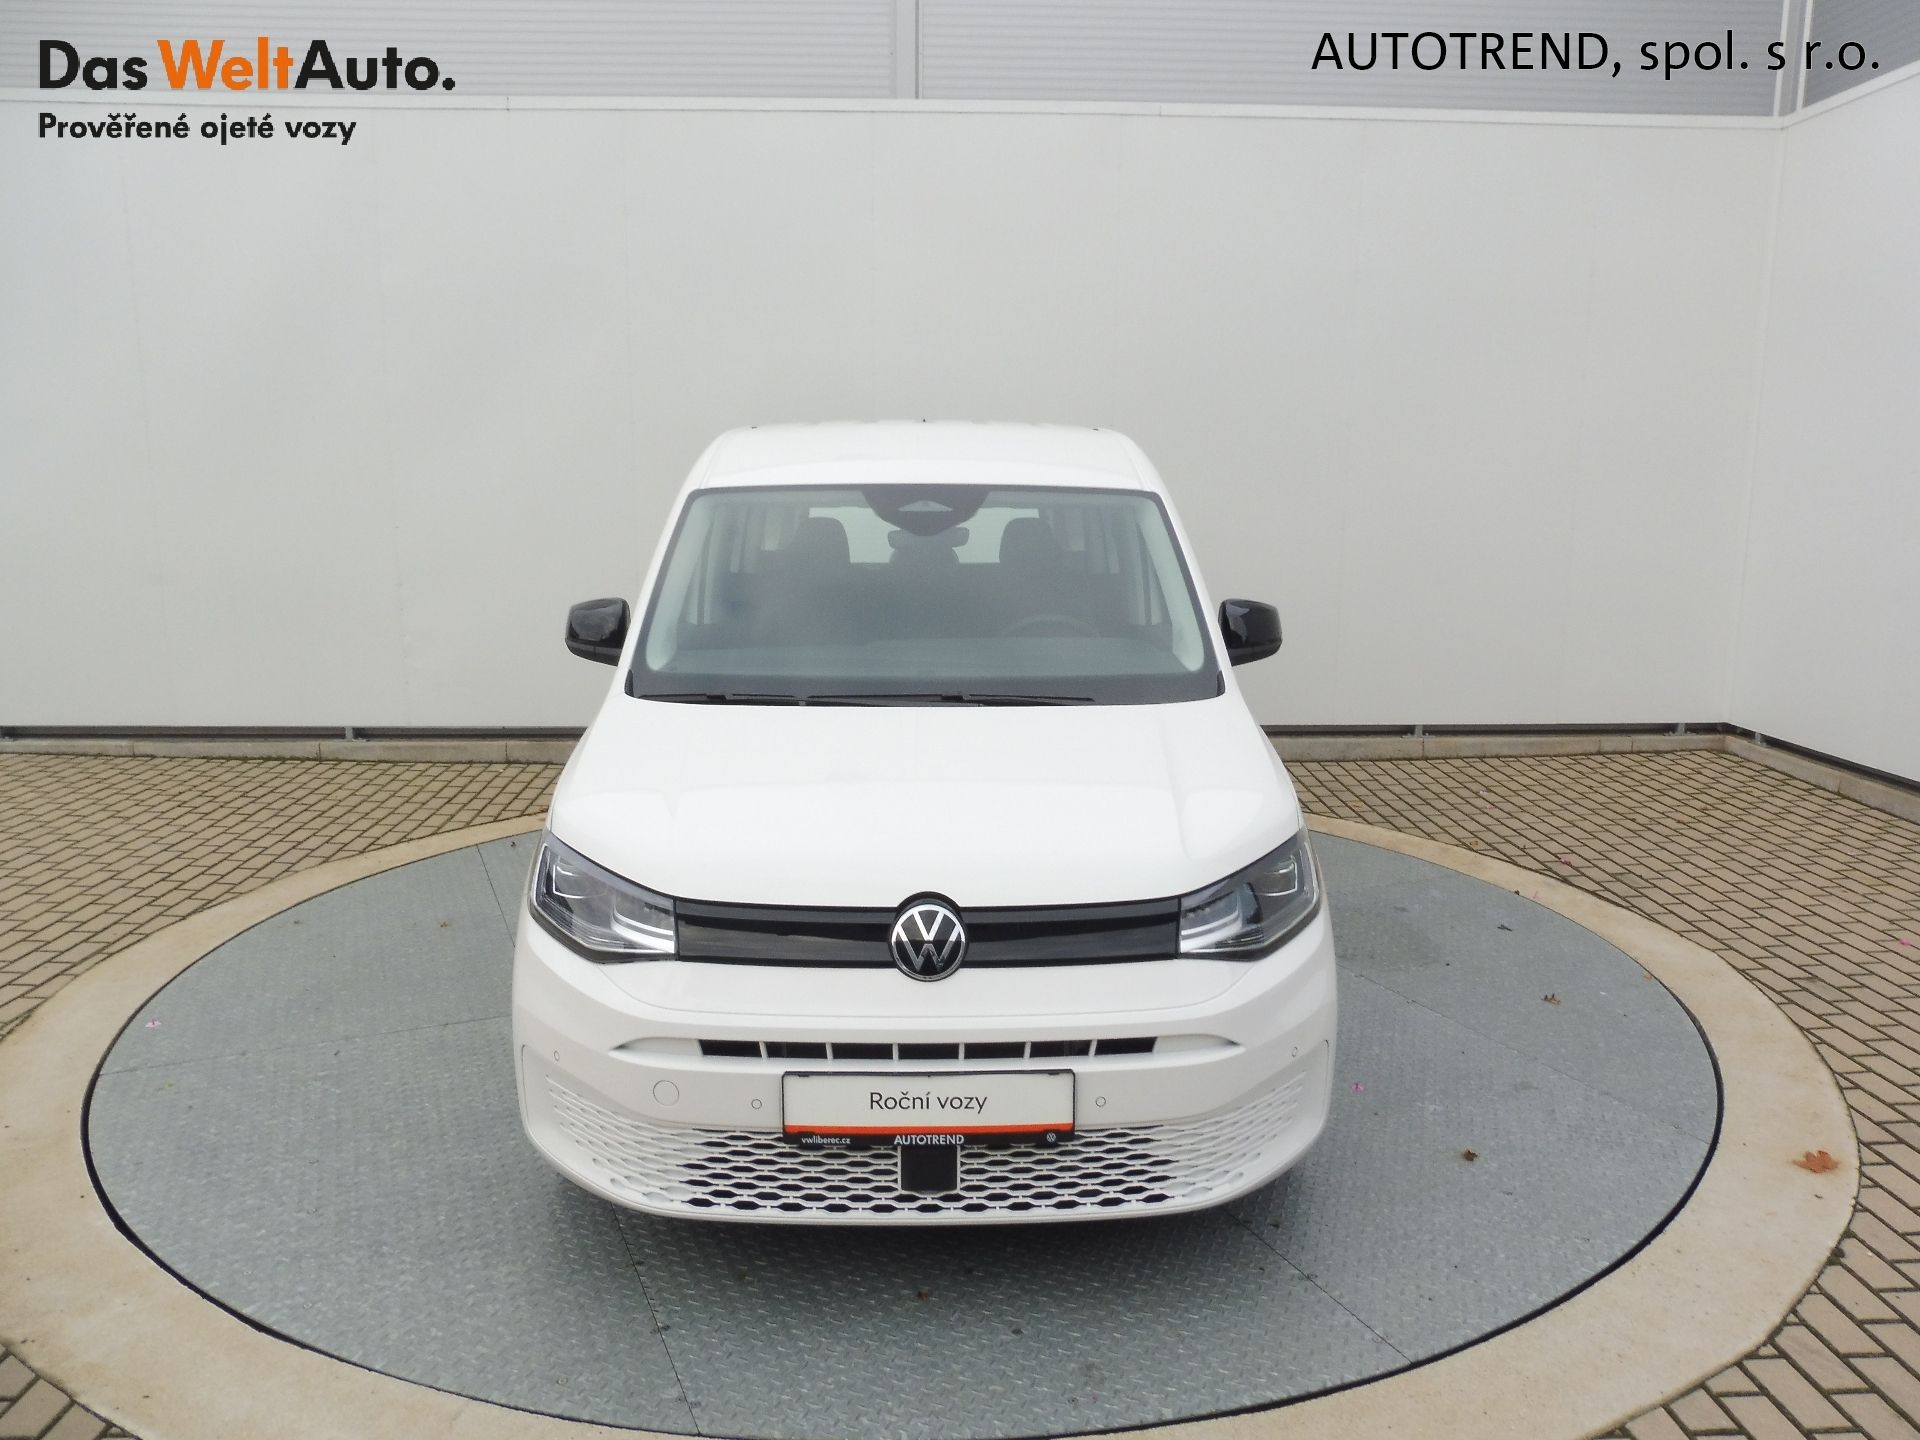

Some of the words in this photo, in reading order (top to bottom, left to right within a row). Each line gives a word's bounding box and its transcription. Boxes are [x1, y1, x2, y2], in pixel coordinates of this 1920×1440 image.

[869, 1091, 931, 1110] Roční
[936, 1096, 988, 1114] vozy
[801, 1135, 851, 1145] vwliberec.cz
[893, 1134, 965, 1145] AUTOTREND
